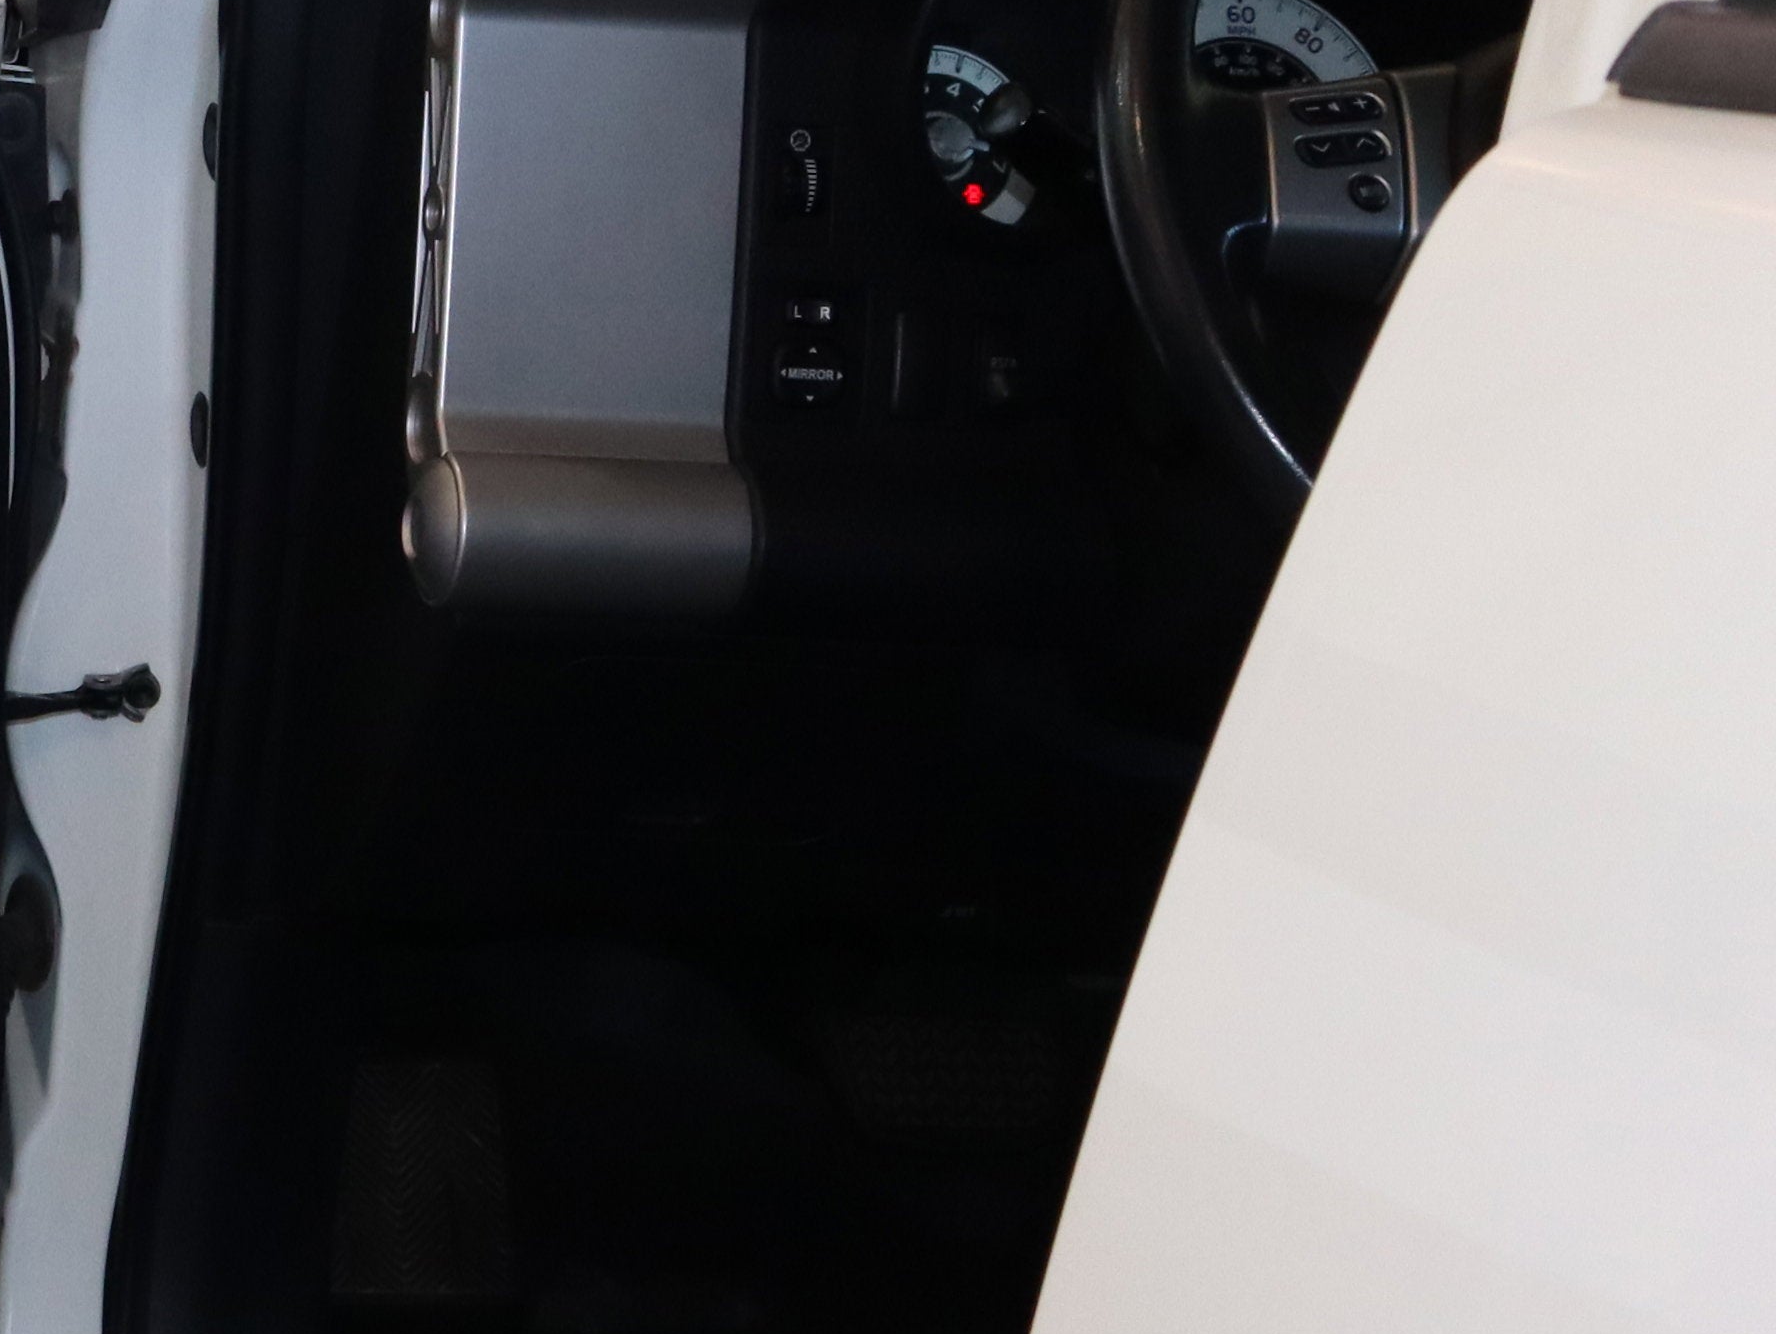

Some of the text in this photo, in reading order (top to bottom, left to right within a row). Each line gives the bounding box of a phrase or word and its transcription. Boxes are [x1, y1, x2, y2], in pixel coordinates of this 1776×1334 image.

[1227, 5, 1256, 24] 60
[1294, 27, 1324, 54] 80
[946, 82, 961, 97] 4
[794, 305, 831, 320] L R
[788, 368, 834, 381] MIRROR
